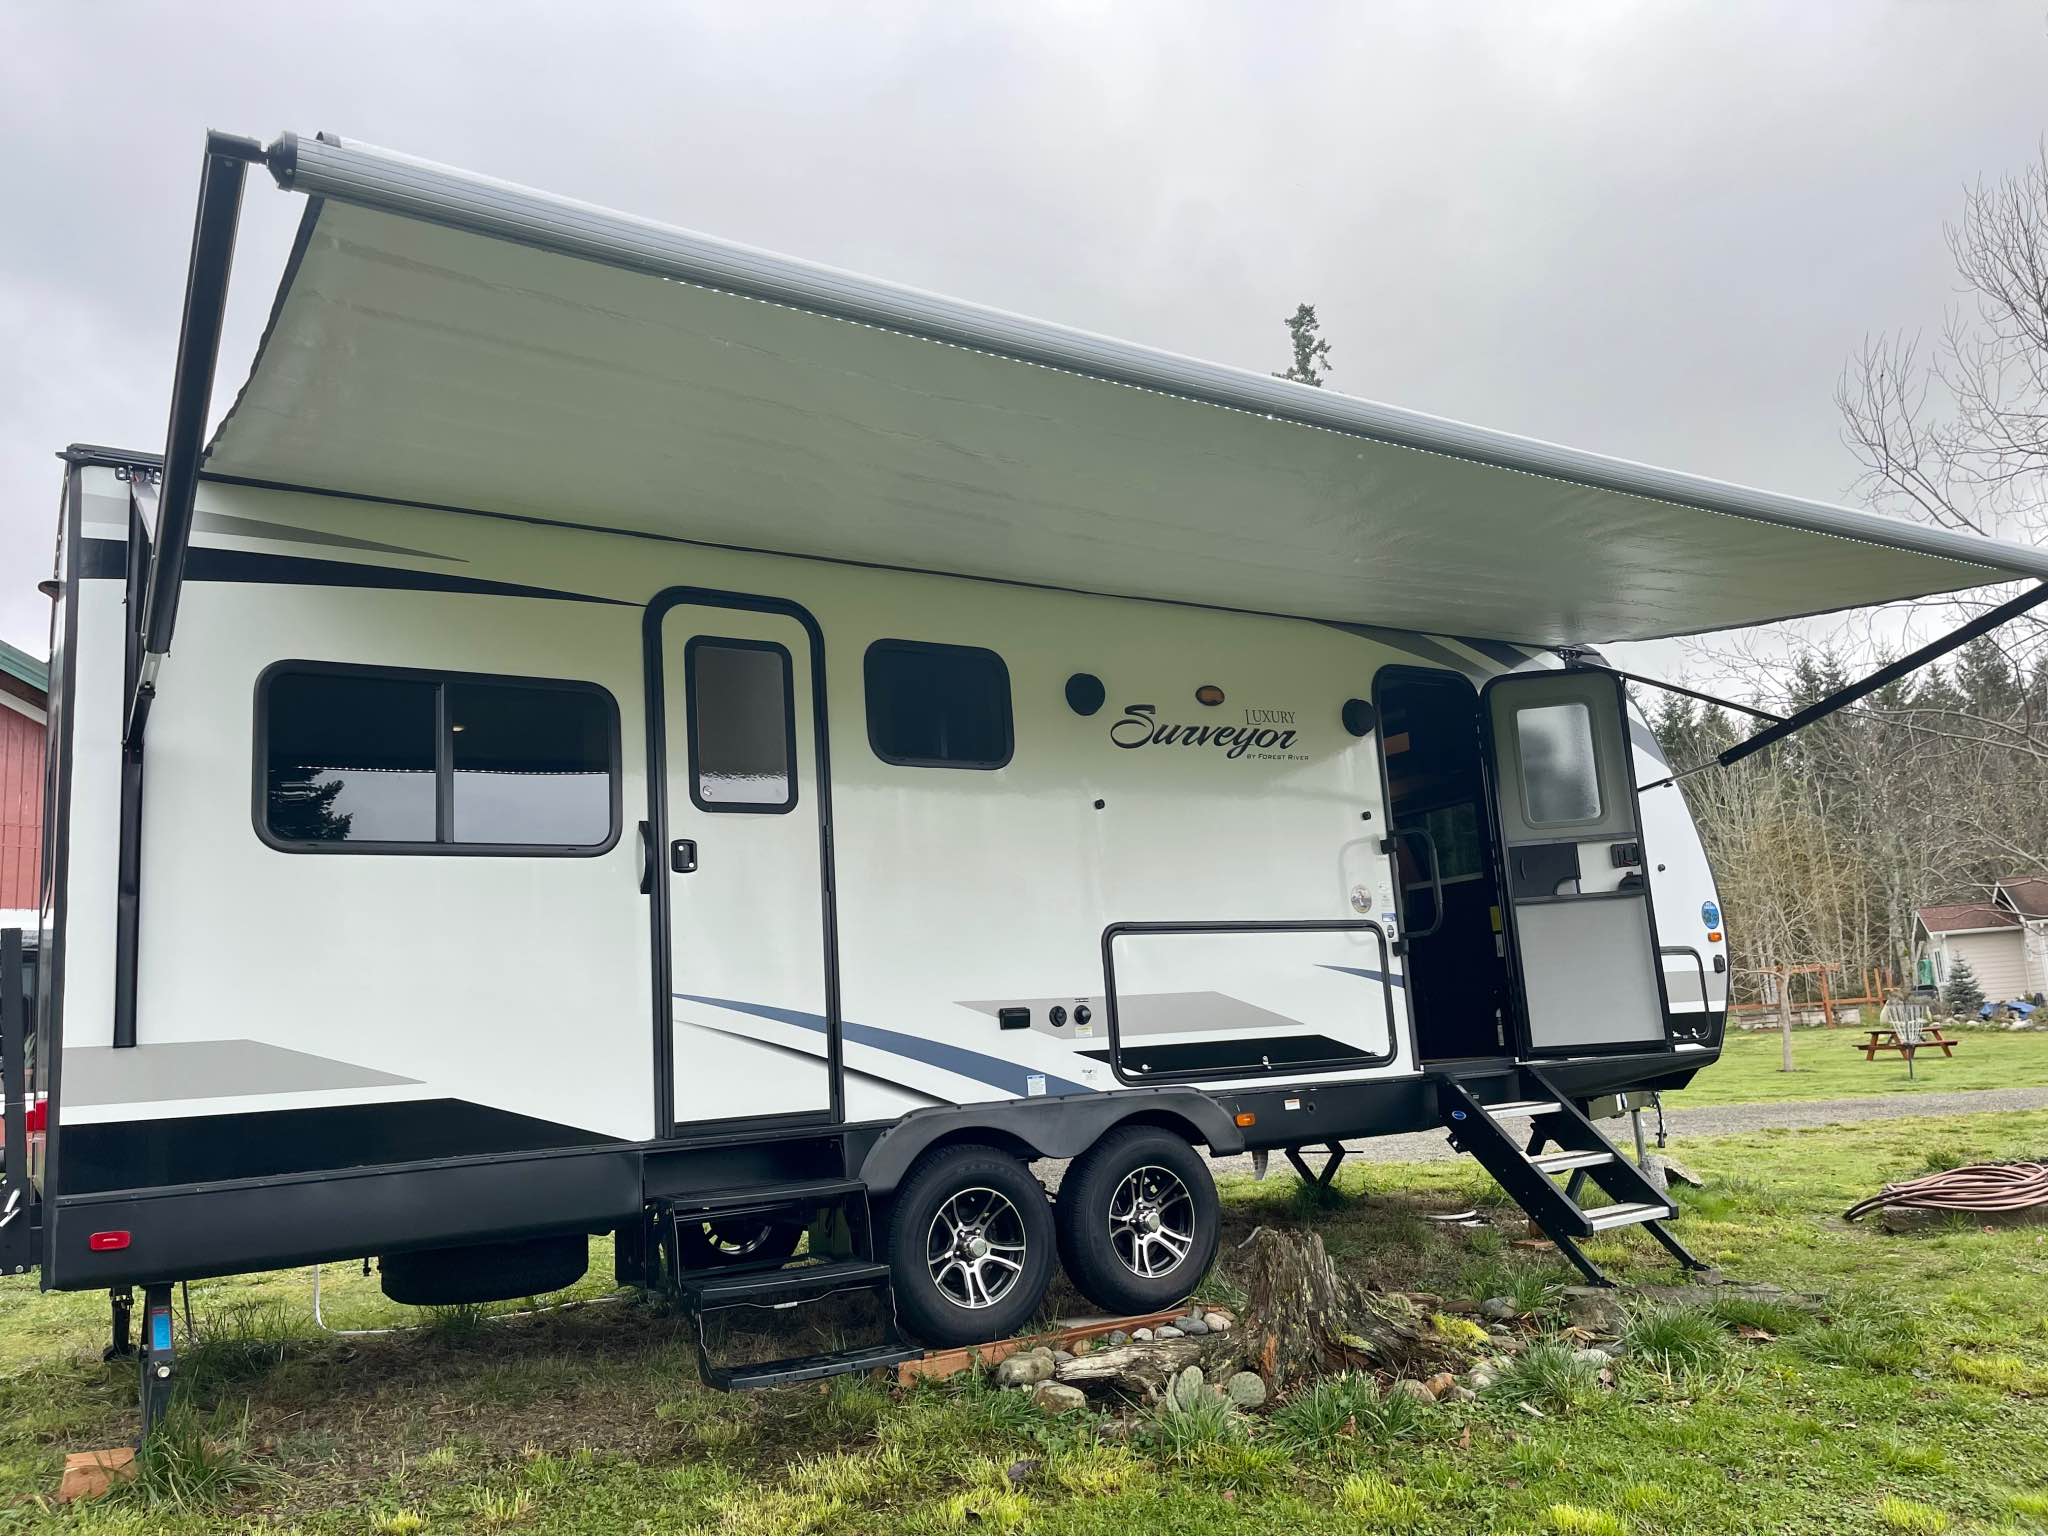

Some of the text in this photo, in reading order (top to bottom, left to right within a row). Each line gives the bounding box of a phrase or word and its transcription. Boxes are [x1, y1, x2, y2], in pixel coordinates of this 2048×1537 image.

[1245, 709, 1295, 725] LUXURY
[1110, 704, 1298, 759] Surveyor
[1258, 753, 1286, 761] FOREST
